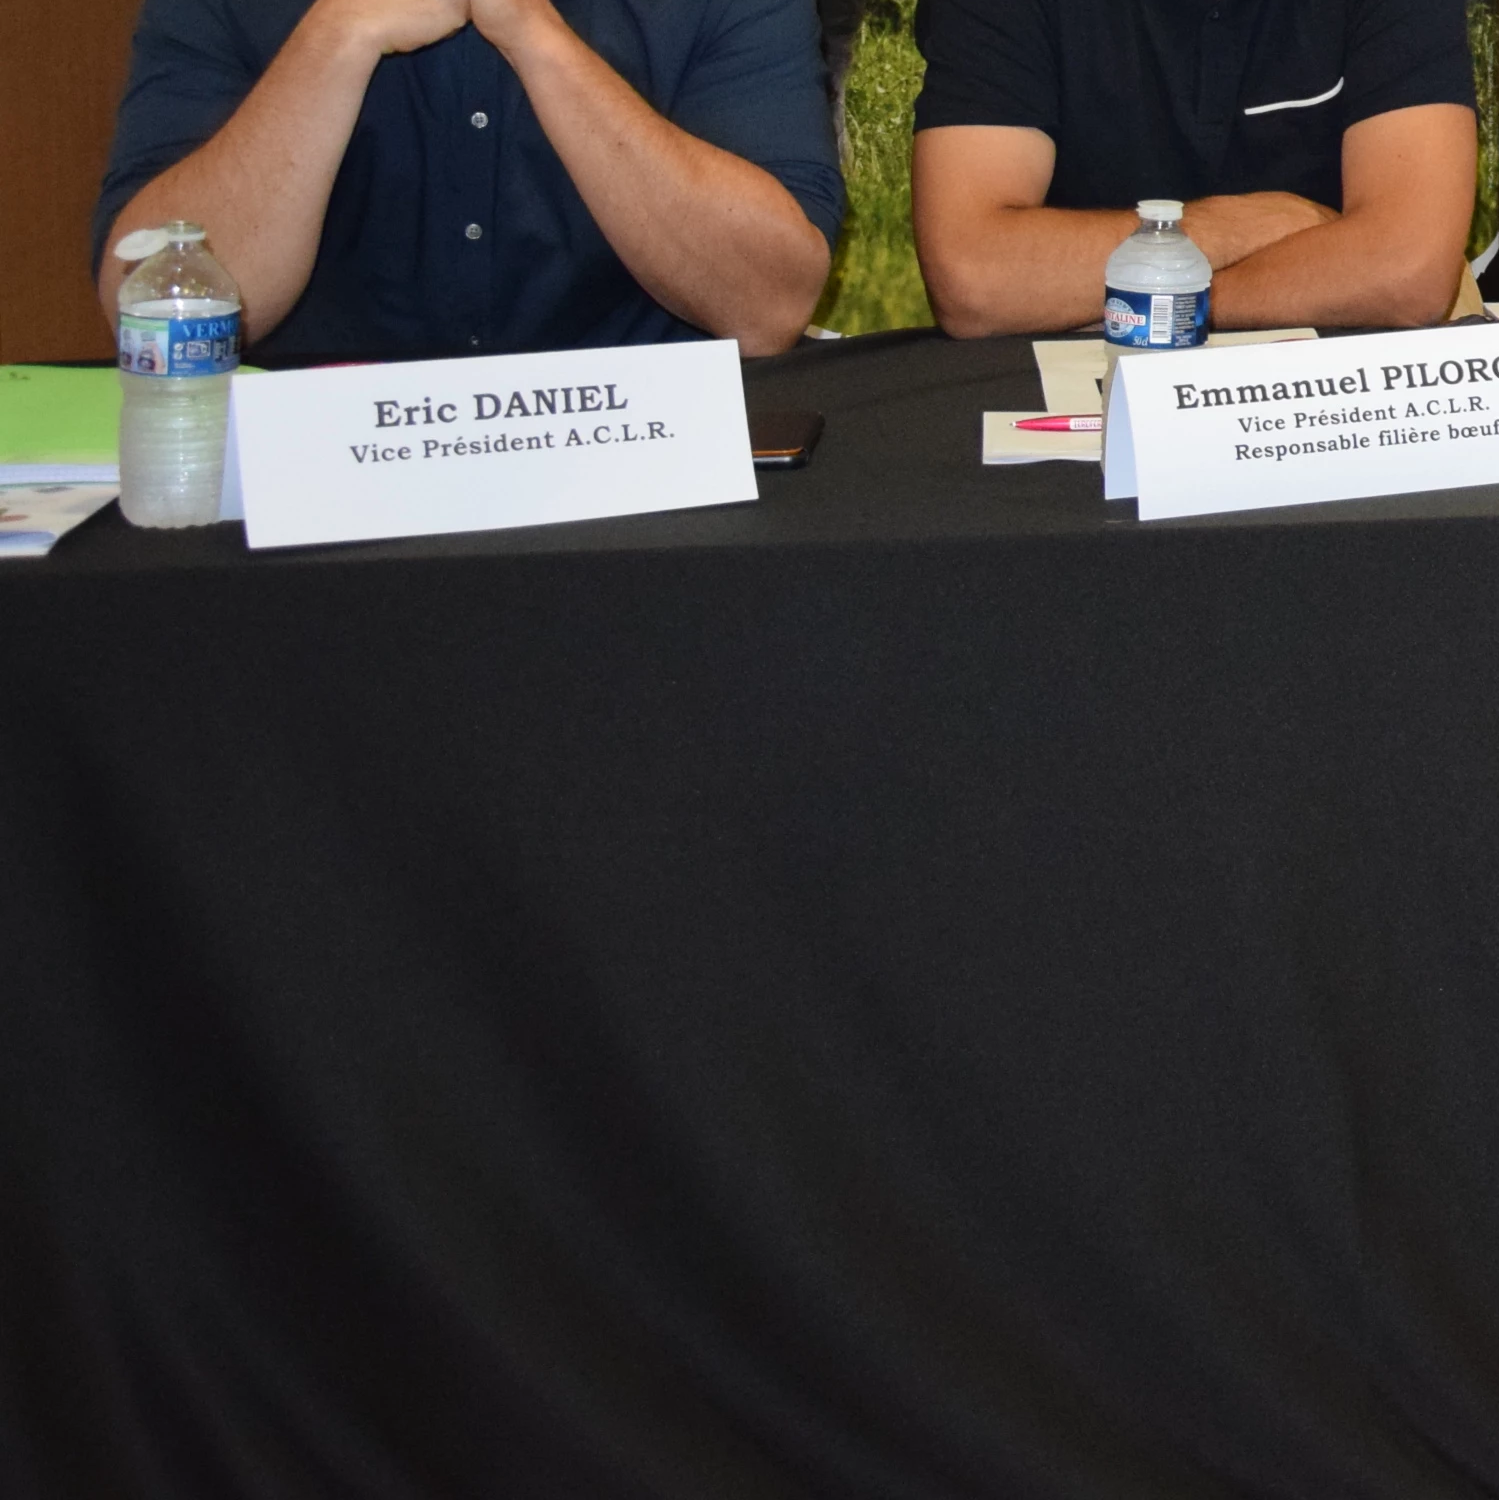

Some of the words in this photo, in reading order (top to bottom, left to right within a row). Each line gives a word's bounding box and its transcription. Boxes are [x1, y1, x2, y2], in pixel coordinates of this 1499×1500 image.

[374, 397, 458, 428] Eric
[473, 384, 628, 420] DANIEL
[1173, 367, 1371, 409] Emmanuel
[1237, 416, 1286, 433] Vice
[1294, 404, 1397, 428] Président
[1404, 396, 1490, 418] A.C.L.R.
[350, 442, 412, 463] Vice
[422, 431, 555, 458] Président
[565, 420, 676, 447] A.C.L.R.
[1235, 432, 1370, 461] Responsable
[1379, 424, 1441, 447] filière
